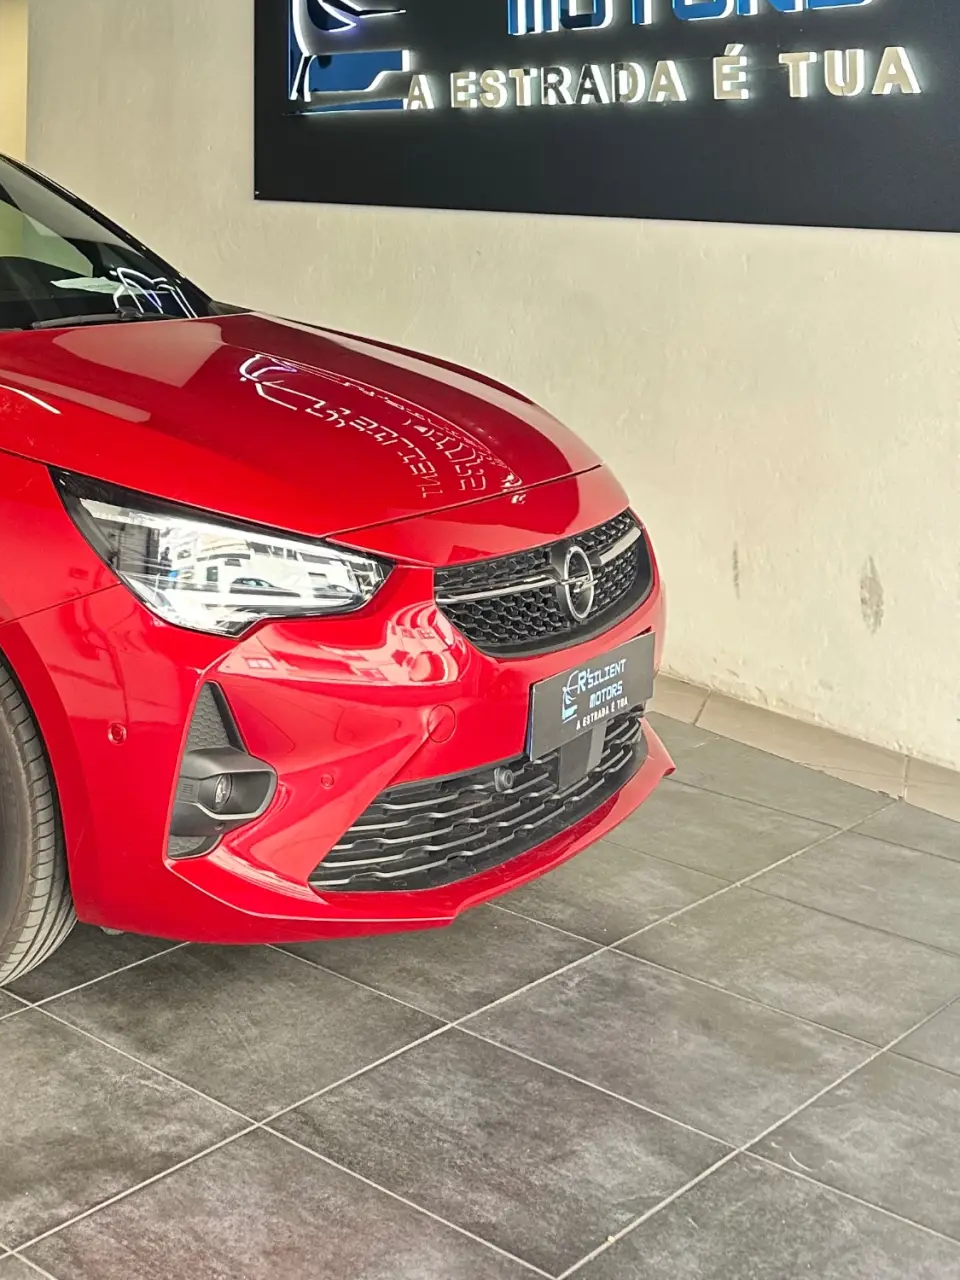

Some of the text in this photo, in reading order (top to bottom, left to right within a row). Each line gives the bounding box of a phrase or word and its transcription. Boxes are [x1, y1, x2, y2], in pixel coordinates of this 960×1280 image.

[403, 43, 922, 110] A ESTRADA É TUA
[589, 680, 623, 708] MOTORS
[576, 720, 581, 731] A
